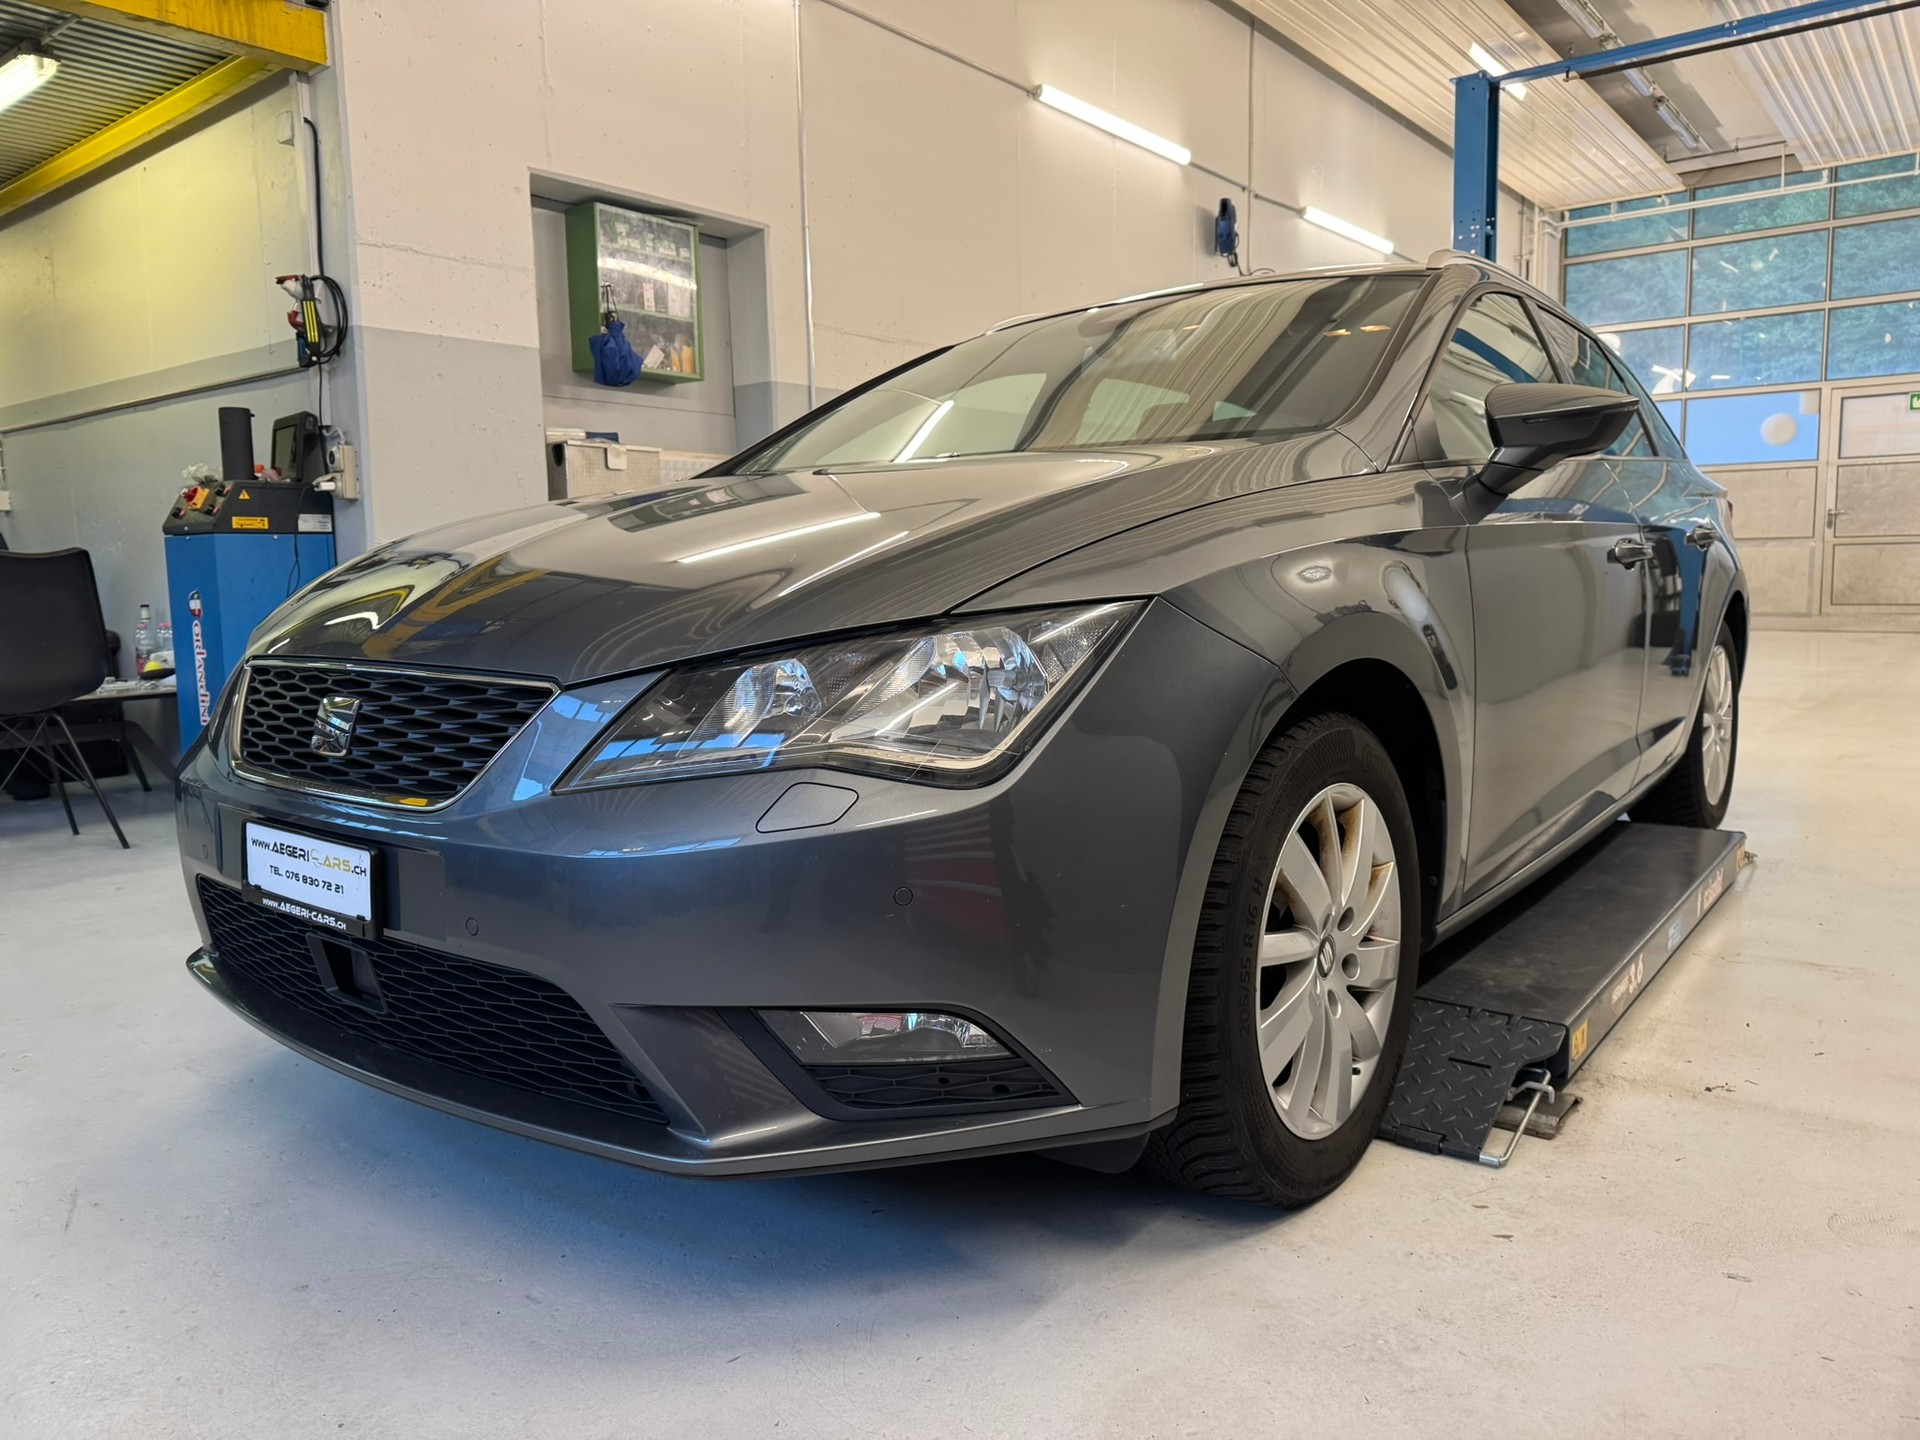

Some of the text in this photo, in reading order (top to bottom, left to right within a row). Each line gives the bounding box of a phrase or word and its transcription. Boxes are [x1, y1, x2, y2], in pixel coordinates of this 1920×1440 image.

[269, 865, 344, 894] TEL. 076 830 72 21
